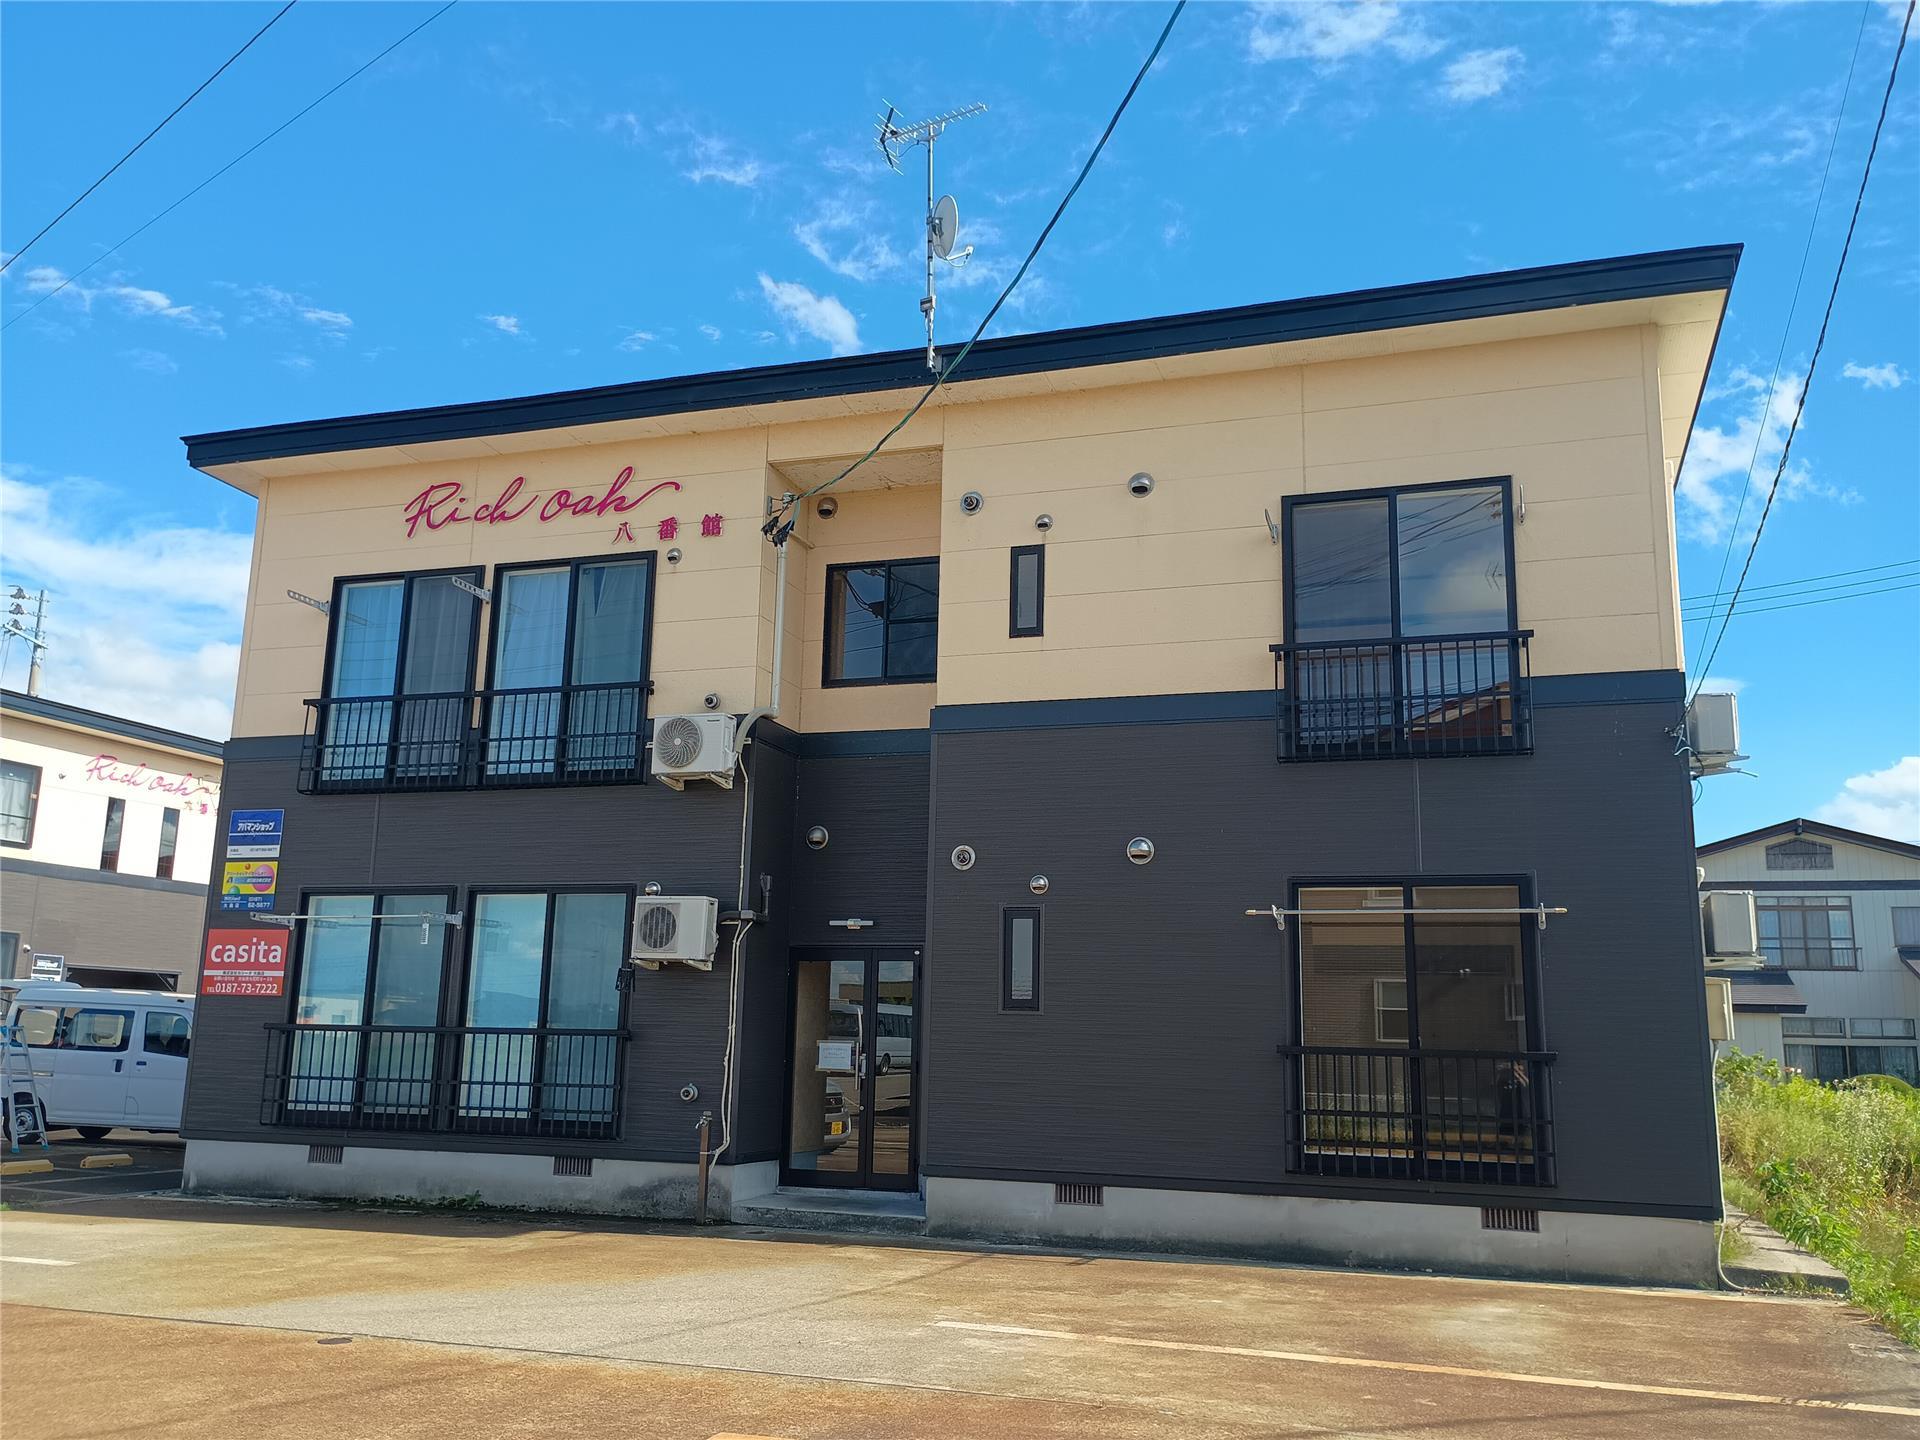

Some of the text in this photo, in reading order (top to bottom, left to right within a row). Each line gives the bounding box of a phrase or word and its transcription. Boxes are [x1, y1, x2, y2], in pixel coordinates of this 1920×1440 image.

[403, 474, 539, 538] Rich
[612, 512, 725, 545] 八番館
[86, 754, 149, 786] Rich
[237, 821, 275, 832] アパマンショップ
[210, 936, 282, 963] casita
[215, 983, 278, 994] 0187-73-7222
